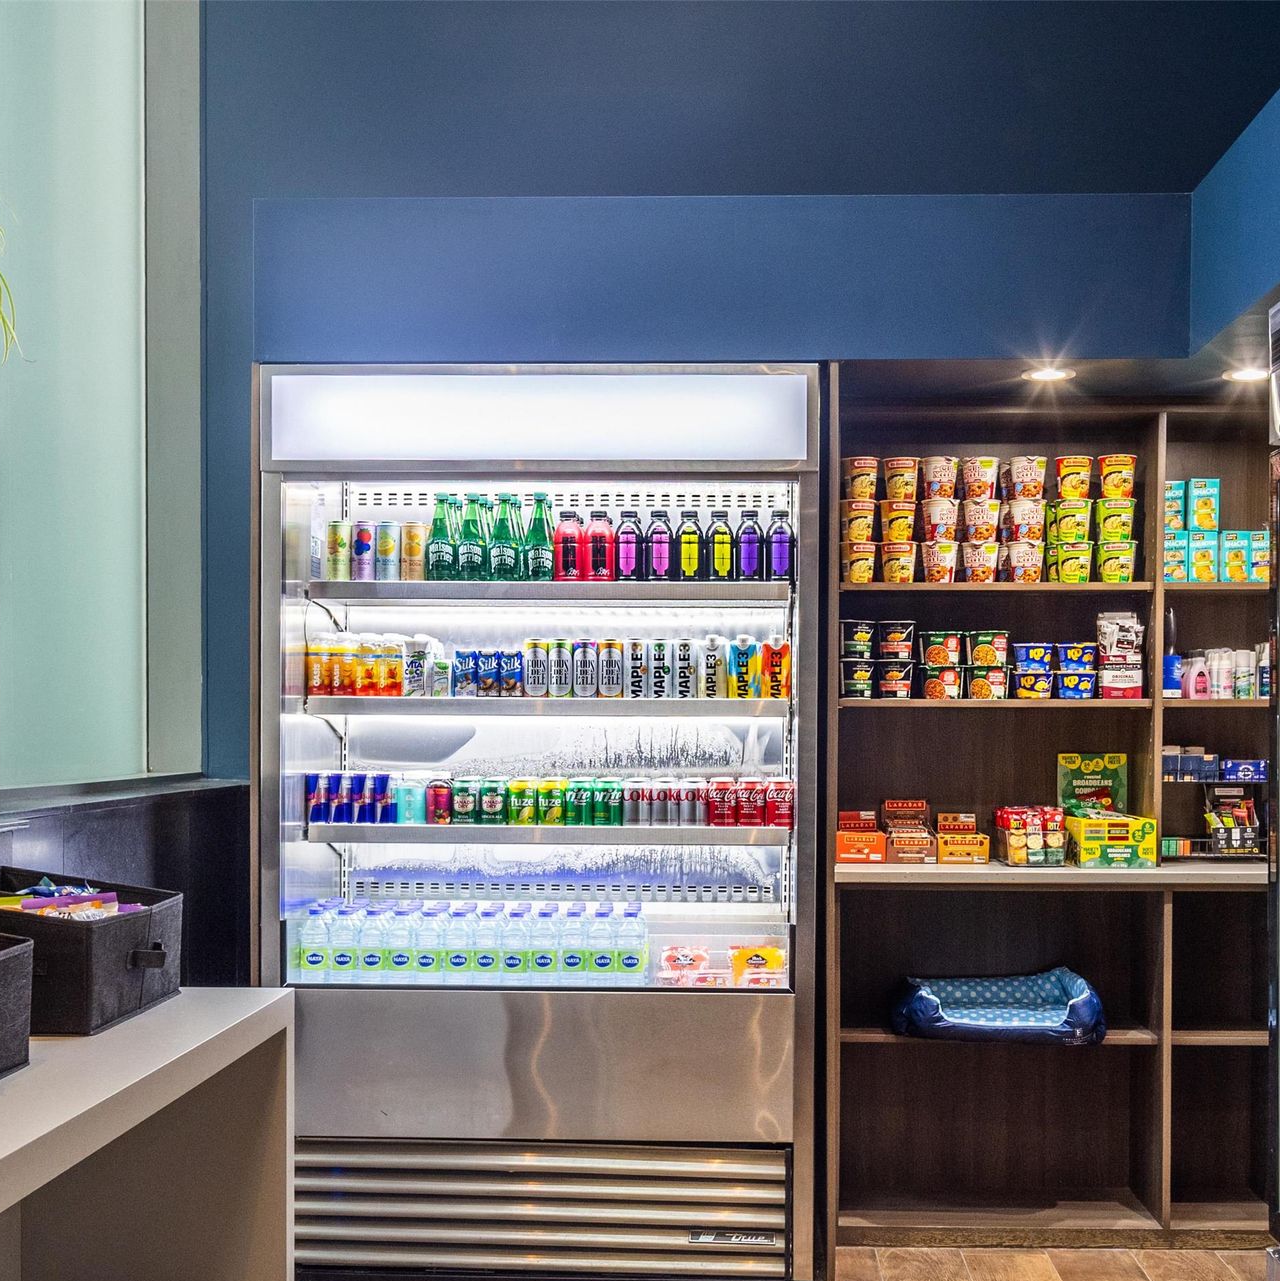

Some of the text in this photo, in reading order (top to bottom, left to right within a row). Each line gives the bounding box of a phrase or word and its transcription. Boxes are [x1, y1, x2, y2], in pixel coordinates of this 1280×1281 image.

[455, 657, 476, 673] Silk
[478, 658, 498, 673] Silk
[500, 658, 521, 673] Silk
[510, 796, 534, 807] fuze
[538, 796, 561, 807] fuze
